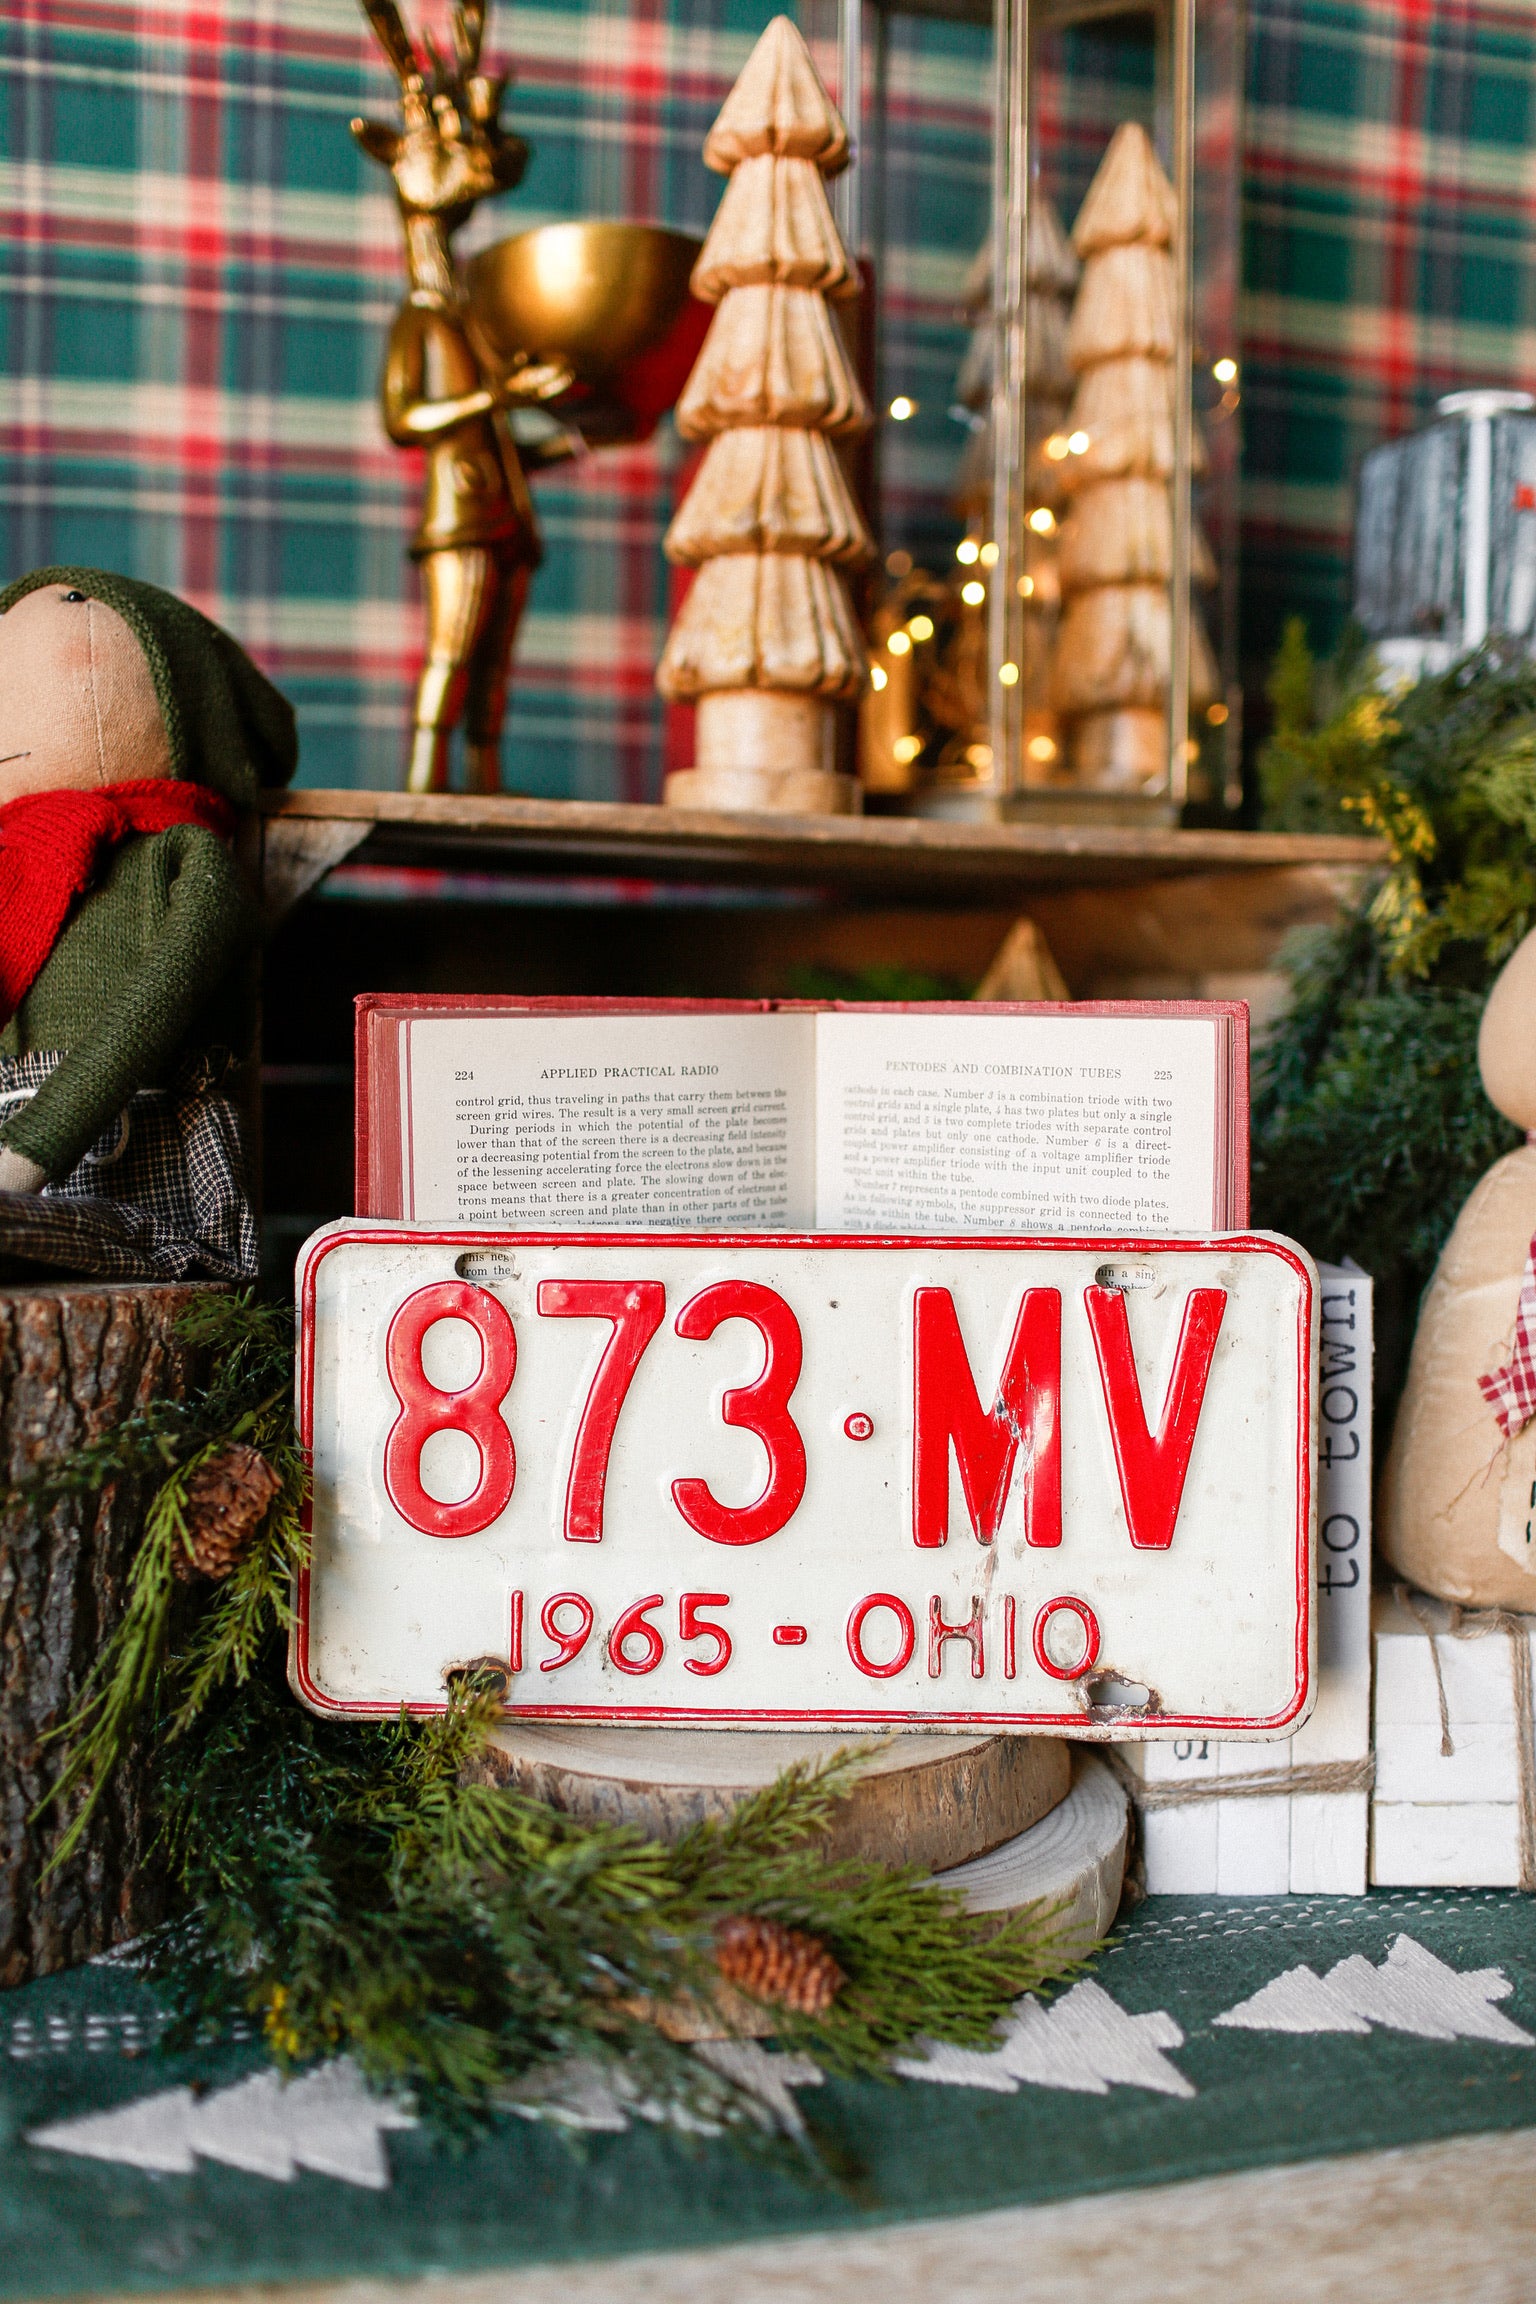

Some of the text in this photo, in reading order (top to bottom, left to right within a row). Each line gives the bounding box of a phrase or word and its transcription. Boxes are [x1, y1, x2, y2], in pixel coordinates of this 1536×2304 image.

[455, 1065, 718, 1080] 224 APPLIED PRACTICAL RADIO
[886, 1061, 1172, 1080] PENTODES AND COMBINATION TUBES 225
[456, 1096, 494, 1106] control
[528, 1095, 551, 1104] thus
[555, 1094, 603, 1104] traveling
[622, 1093, 650, 1102] paths
[654, 1093, 674, 1101] that
[678, 1094, 705, 1103] carry
[709, 1091, 732, 1099] them
[944, 1088, 1172, 1107] Number combination triode with two
[456, 1111, 490, 1120] screen
[495, 1110, 517, 1121] grid
[559, 1108, 579, 1118] The
[584, 1108, 613, 1117] result
[641, 1108, 663, 1117] very
[667, 1105, 693, 1115] small
[698, 1106, 728, 1114] screen
[933, 1103, 961, 1113] single
[1005, 1105, 1022, 1115] has
[1025, 1106, 1044, 1115] two
[1048, 1107, 1079, 1118] plates
[1083, 1108, 1099, 1118] but
[1104, 1110, 1126, 1121] only
[1140, 1111, 1172, 1122] single
[470, 1125, 509, 1135] During
[516, 1124, 555, 1135] periods
[562, 1123, 571, 1131] in
[579, 1122, 609, 1131] which
[616, 1121, 632, 1130] the
[639, 1119, 683, 1131] potential
[689, 1119, 700, 1128] of
[706, 1118, 720, 1127] the
[967, 1118, 1171, 1136] complete triodes with separate control
[457, 1134, 724, 1149] lower than that of the screen there decreasing
[1046, 1136, 1088, 1146] Number
[457, 1155, 468, 1163] or
[481, 1153, 539, 1163] decreasing
[543, 1151, 590, 1163] potential
[594, 1150, 619, 1159] from
[623, 1149, 639, 1158] the
[690, 1147, 705, 1155] the
[960, 1147, 1170, 1165] consisting voltage amplifier triode
[457, 1161, 709, 1177] of the lessening accelerating force the electrons
[951, 1159, 980, 1169] triode
[985, 1161, 1007, 1170] with
[1013, 1163, 1028, 1172] the
[1033, 1164, 1060, 1174] input
[1066, 1166, 1087, 1175] unit
[1092, 1168, 1131, 1178] coupled
[1138, 1171, 1147, 1179] to
[1153, 1170, 1170, 1179] the
[458, 1182, 487, 1192] space
[493, 1181, 536, 1190] between
[543, 1180, 576, 1189] screen
[582, 1178, 601, 1187] and
[641, 1176, 661, 1185] The
[666, 1174, 703, 1185] slowing
[458, 1187, 720, 1205] trons means that there greater concentration
[960, 1187, 998, 1198] pentode
[1001, 1190, 1049, 1202] combined
[1053, 1193, 1076, 1203] with
[1080, 1195, 1099, 1204] two
[1102, 1196, 1131, 1206] diode
[469, 1199, 737, 1221] point between screen and plate than in other parts
[697, 1213, 722, 1224] there
[961, 1200, 976, 1210] the
[980, 1204, 1035, 1214] suppressor
[1040, 1207, 1061, 1216] grid
[1080, 1209, 1132, 1221] connected
[1137, 1213, 1147, 1221] to
[1152, 1213, 1169, 1223] the
[964, 1215, 1004, 1226] Number
[1021, 1219, 1053, 1230] shows
[494, 1265, 510, 1274] the
[1122, 1270, 1128, 1278] a
[1318, 1289, 1360, 1596] to town
[511, 1589, 730, 1676] 1965
[846, 1592, 1101, 1681] OHIO
